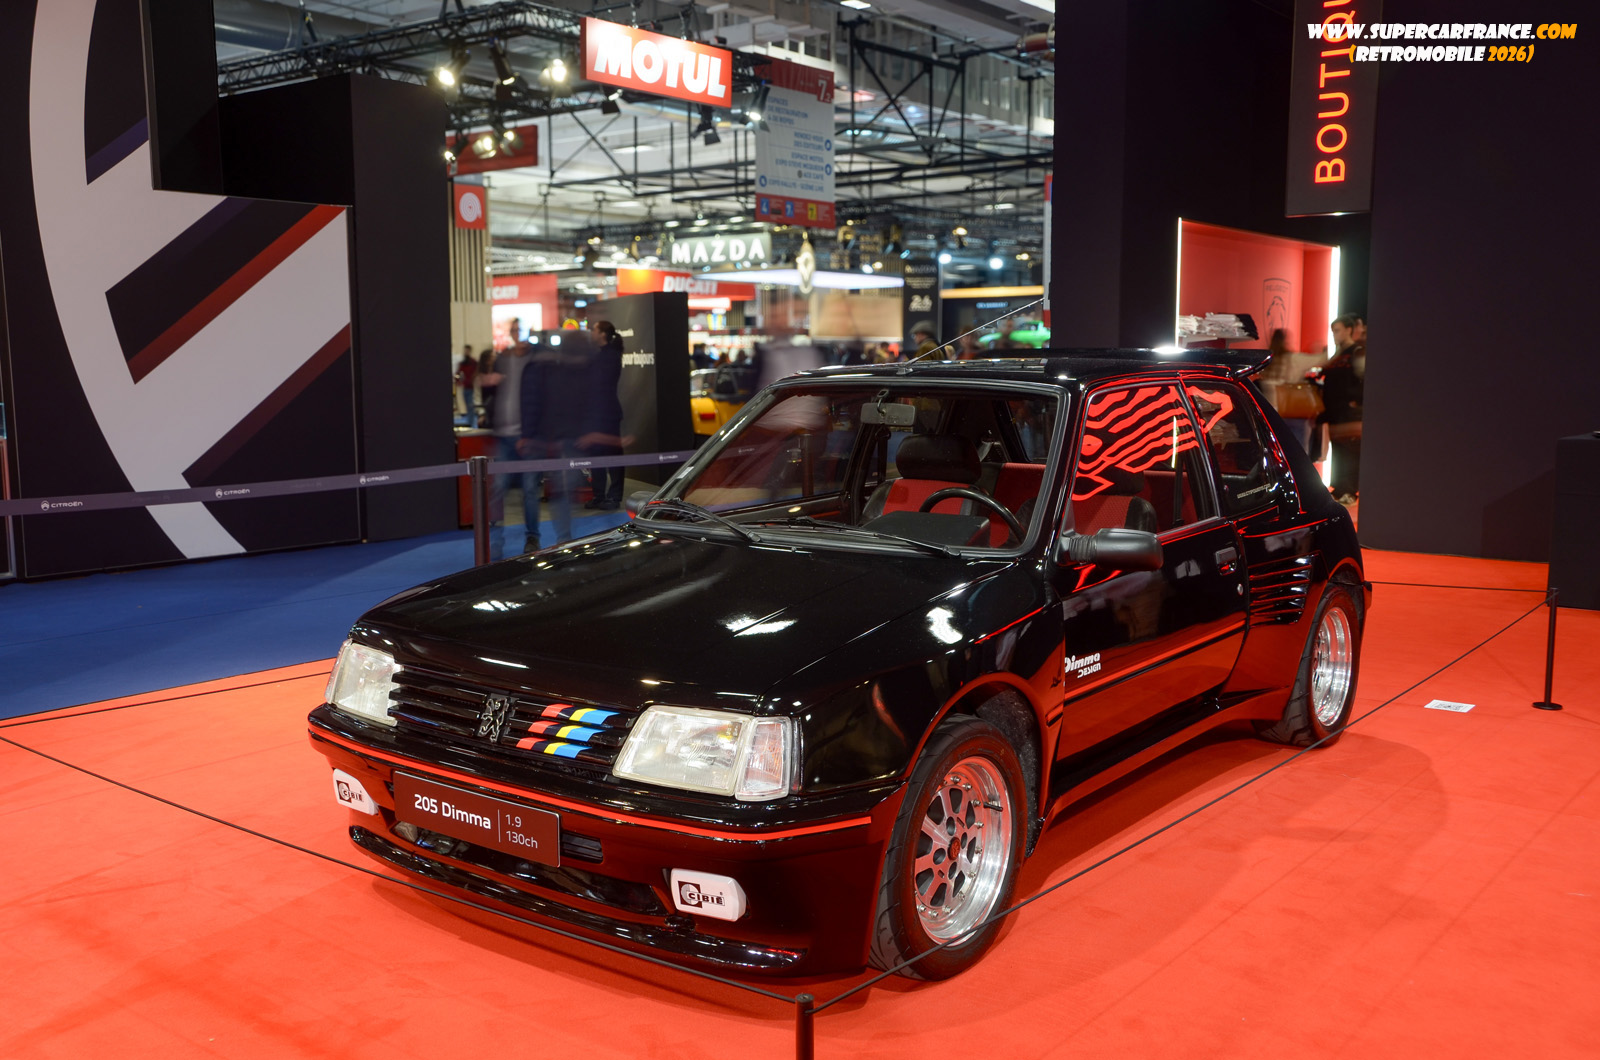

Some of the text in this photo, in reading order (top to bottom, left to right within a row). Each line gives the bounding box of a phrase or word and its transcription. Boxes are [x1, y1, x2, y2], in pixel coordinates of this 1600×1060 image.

[594, 32, 726, 98] MOTUL
[672, 238, 765, 264] MAZDA
[663, 275, 718, 295] DUCATI
[1077, 663, 1101, 678] DESIGN
[414, 794, 491, 829] 205 Dimma
[505, 814, 522, 828] 1.9
[506, 830, 538, 848] 130ch
